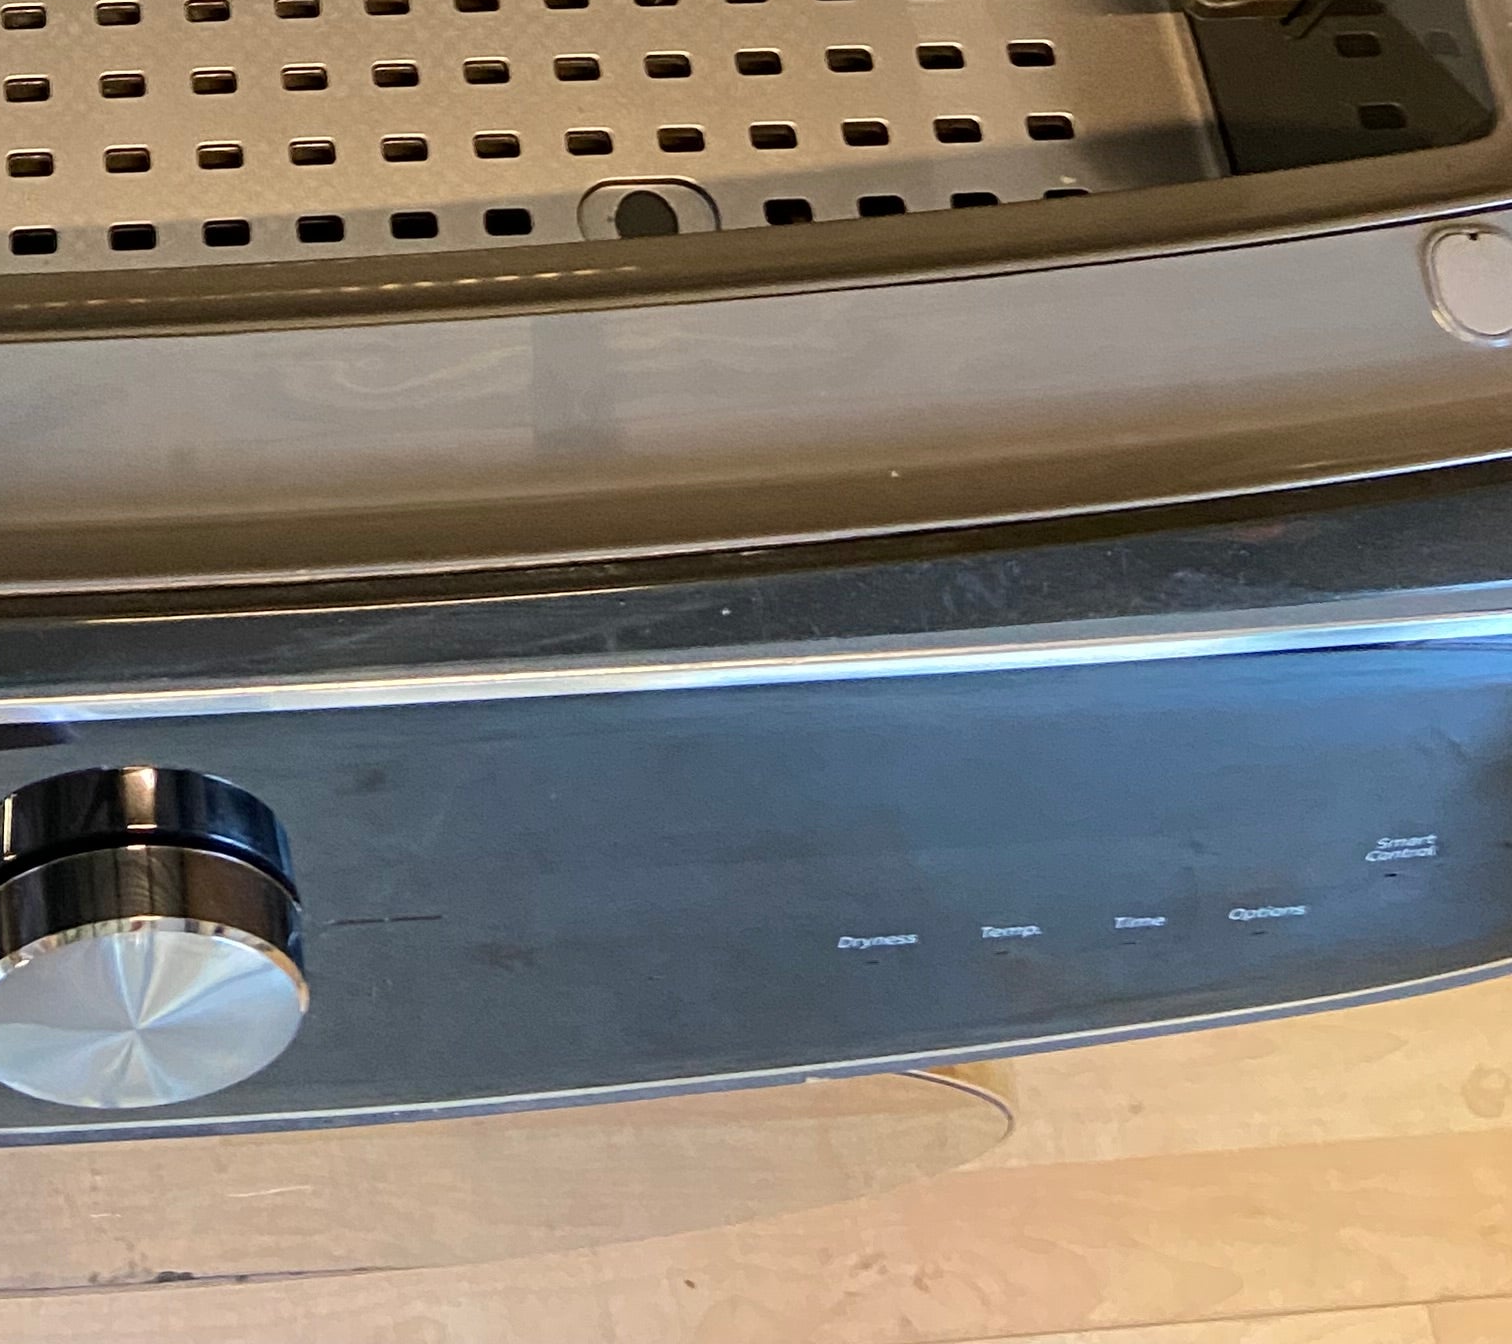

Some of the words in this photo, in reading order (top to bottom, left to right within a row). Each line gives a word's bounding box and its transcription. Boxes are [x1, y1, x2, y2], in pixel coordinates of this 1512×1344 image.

[1365, 846, 1438, 862] Control
[1228, 904, 1307, 921] Options
[837, 933, 918, 949] Dryness
